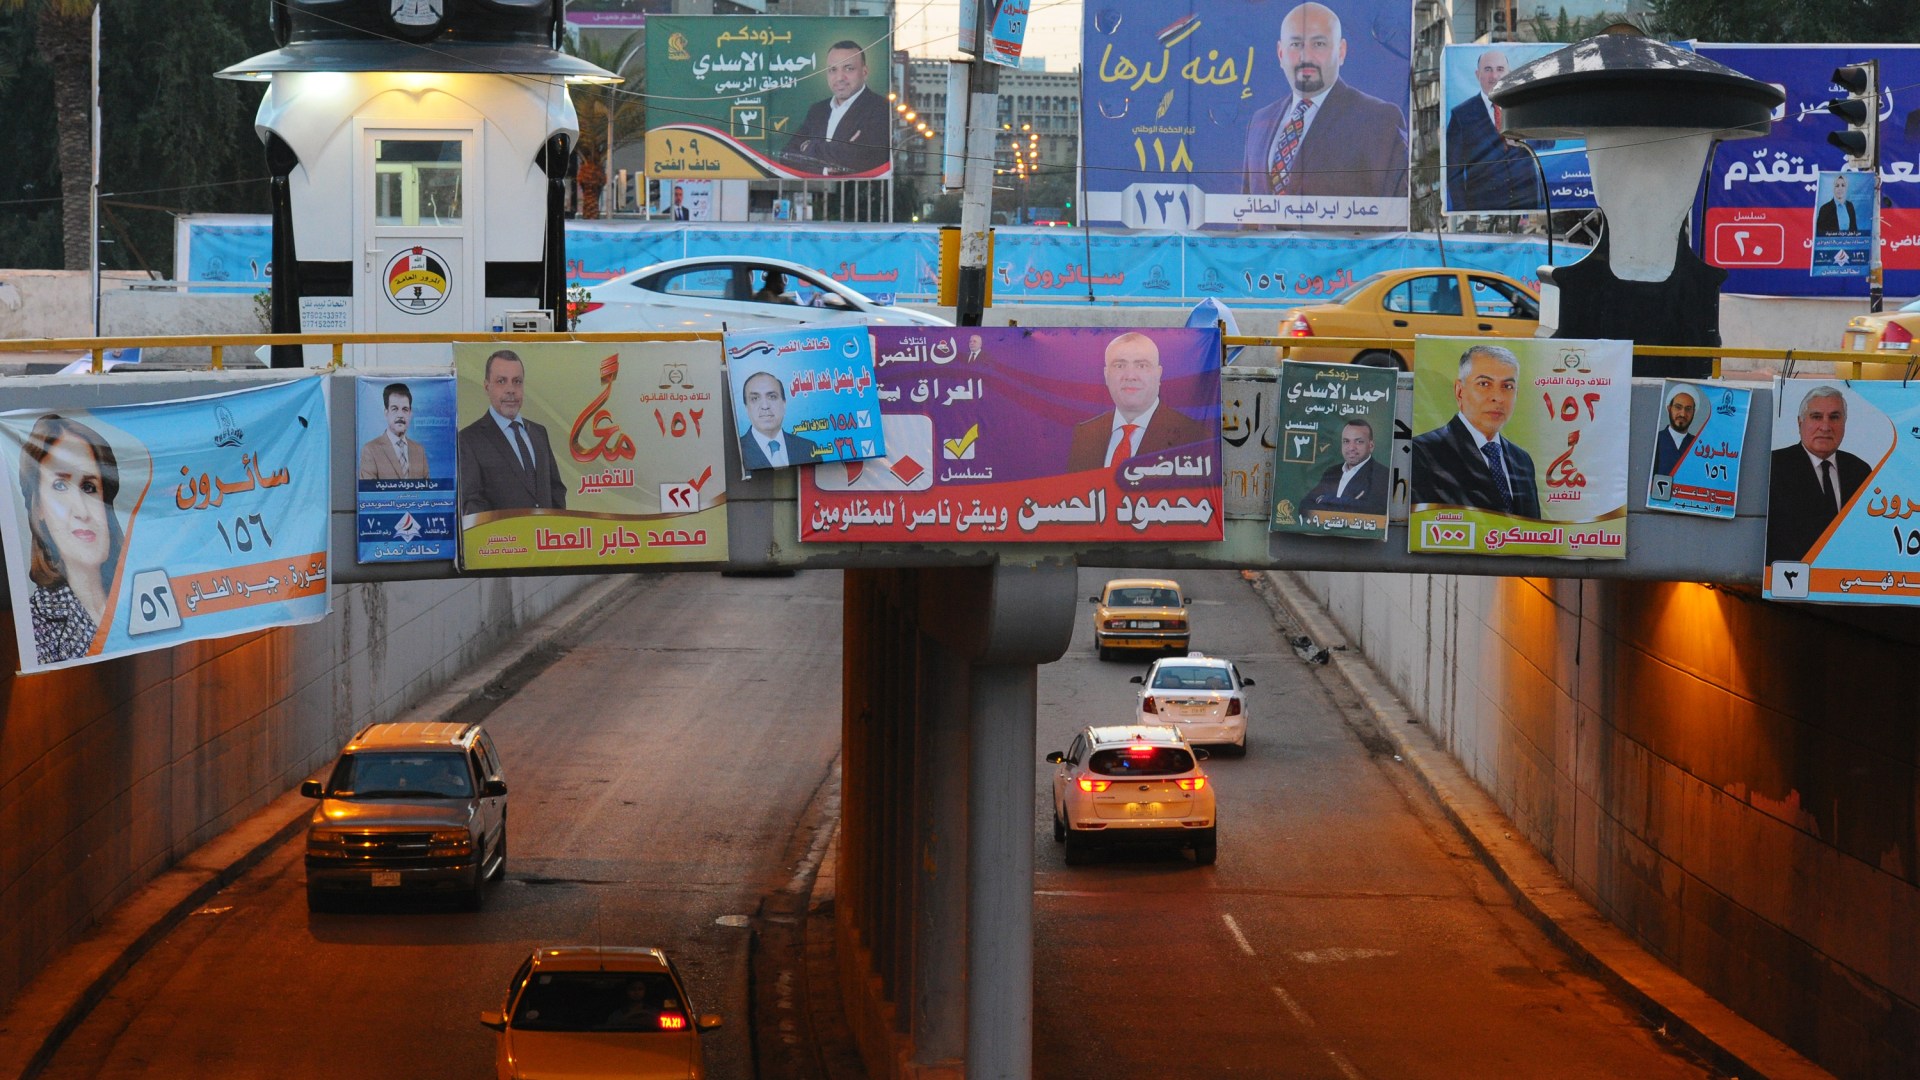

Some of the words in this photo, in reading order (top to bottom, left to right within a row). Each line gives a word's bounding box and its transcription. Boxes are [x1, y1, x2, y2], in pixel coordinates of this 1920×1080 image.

[692, 51, 764, 79] الاسدي
[769, 52, 816, 73] احمد
[715, 76, 757, 93] الرسمي
[759, 77, 797, 92] الناطق
[740, 111, 757, 134] ٣
[665, 138, 700, 155] ١٠٩
[1134, 137, 1194, 172] ١١٨
[653, 159, 685, 173] الفتح
[688, 159, 720, 171] تحالف
[1134, 189, 1191, 225] ١٣١
[1233, 198, 1281, 221] الطائي
[1284, 200, 1339, 220] ابراهيم
[1346, 199, 1379, 217] عمار
[1734, 212, 1766, 221] تسلسل
[1734, 231, 1763, 257] ٢٠
[1245, 271, 1286, 293] ١٥٦
[776, 340, 800, 356] النصر
[801, 337, 831, 351] تحالف
[899, 336, 926, 345] ائتلاف
[878, 345, 928, 366] النصر
[1534, 376, 1564, 387] القانون
[1566, 378, 1586, 387] دولة
[909, 377, 983, 406] العراق
[1286, 382, 1346, 403] الاسدي
[1350, 387, 1390, 403] احمد
[1305, 403, 1338, 414] الرسمي
[1339, 405, 1369, 415] الناطق
[1543, 392, 1600, 422] ١٥٢
[653, 407, 704, 438] ١٥٢
[829, 412, 858, 431] ١٥٨
[1284, 420, 1319, 430] التسلسل
[834, 437, 857, 459] ٣٦
[1694, 440, 1739, 459] سائرون
[940, 467, 993, 482] تسلسل
[1123, 455, 1212, 486] القاضي
[1705, 462, 1728, 480] ١٥٦
[175, 451, 290, 510] سائرون
[578, 468, 635, 495] للتغيير
[1657, 481, 1669, 495] ٢
[668, 487, 691, 507] ٢٢
[1547, 491, 1581, 502] للتغيير
[811, 498, 895, 531] للمظلومين
[1018, 488, 1106, 531] الحسن
[1116, 496, 1215, 530] محمود
[1435, 513, 1462, 521] تسلسل
[367, 518, 381, 529] ٧٠
[426, 517, 446, 528] ١٣٦
[1298, 514, 1320, 527] ١٠٩
[1323, 517, 1348, 530] الفتح
[1349, 518, 1376, 530] تحالف
[217, 513, 272, 554] ١٥٦
[535, 527, 592, 551] العطا
[598, 526, 640, 556] جابر
[647, 528, 707, 547] محمد
[1430, 526, 1465, 544] ١٠٠
[1484, 527, 1563, 549] العسكري
[1568, 528, 1622, 549] سامي
[1893, 525, 1920, 556] ١٥
[405, 544, 439, 555] تحالف
[1783, 569, 1799, 590] ٣
[1839, 571, 1895, 592] فهمي
[139, 585, 170, 622] ٥٢
[660, 1016, 681, 1028] TAXI
